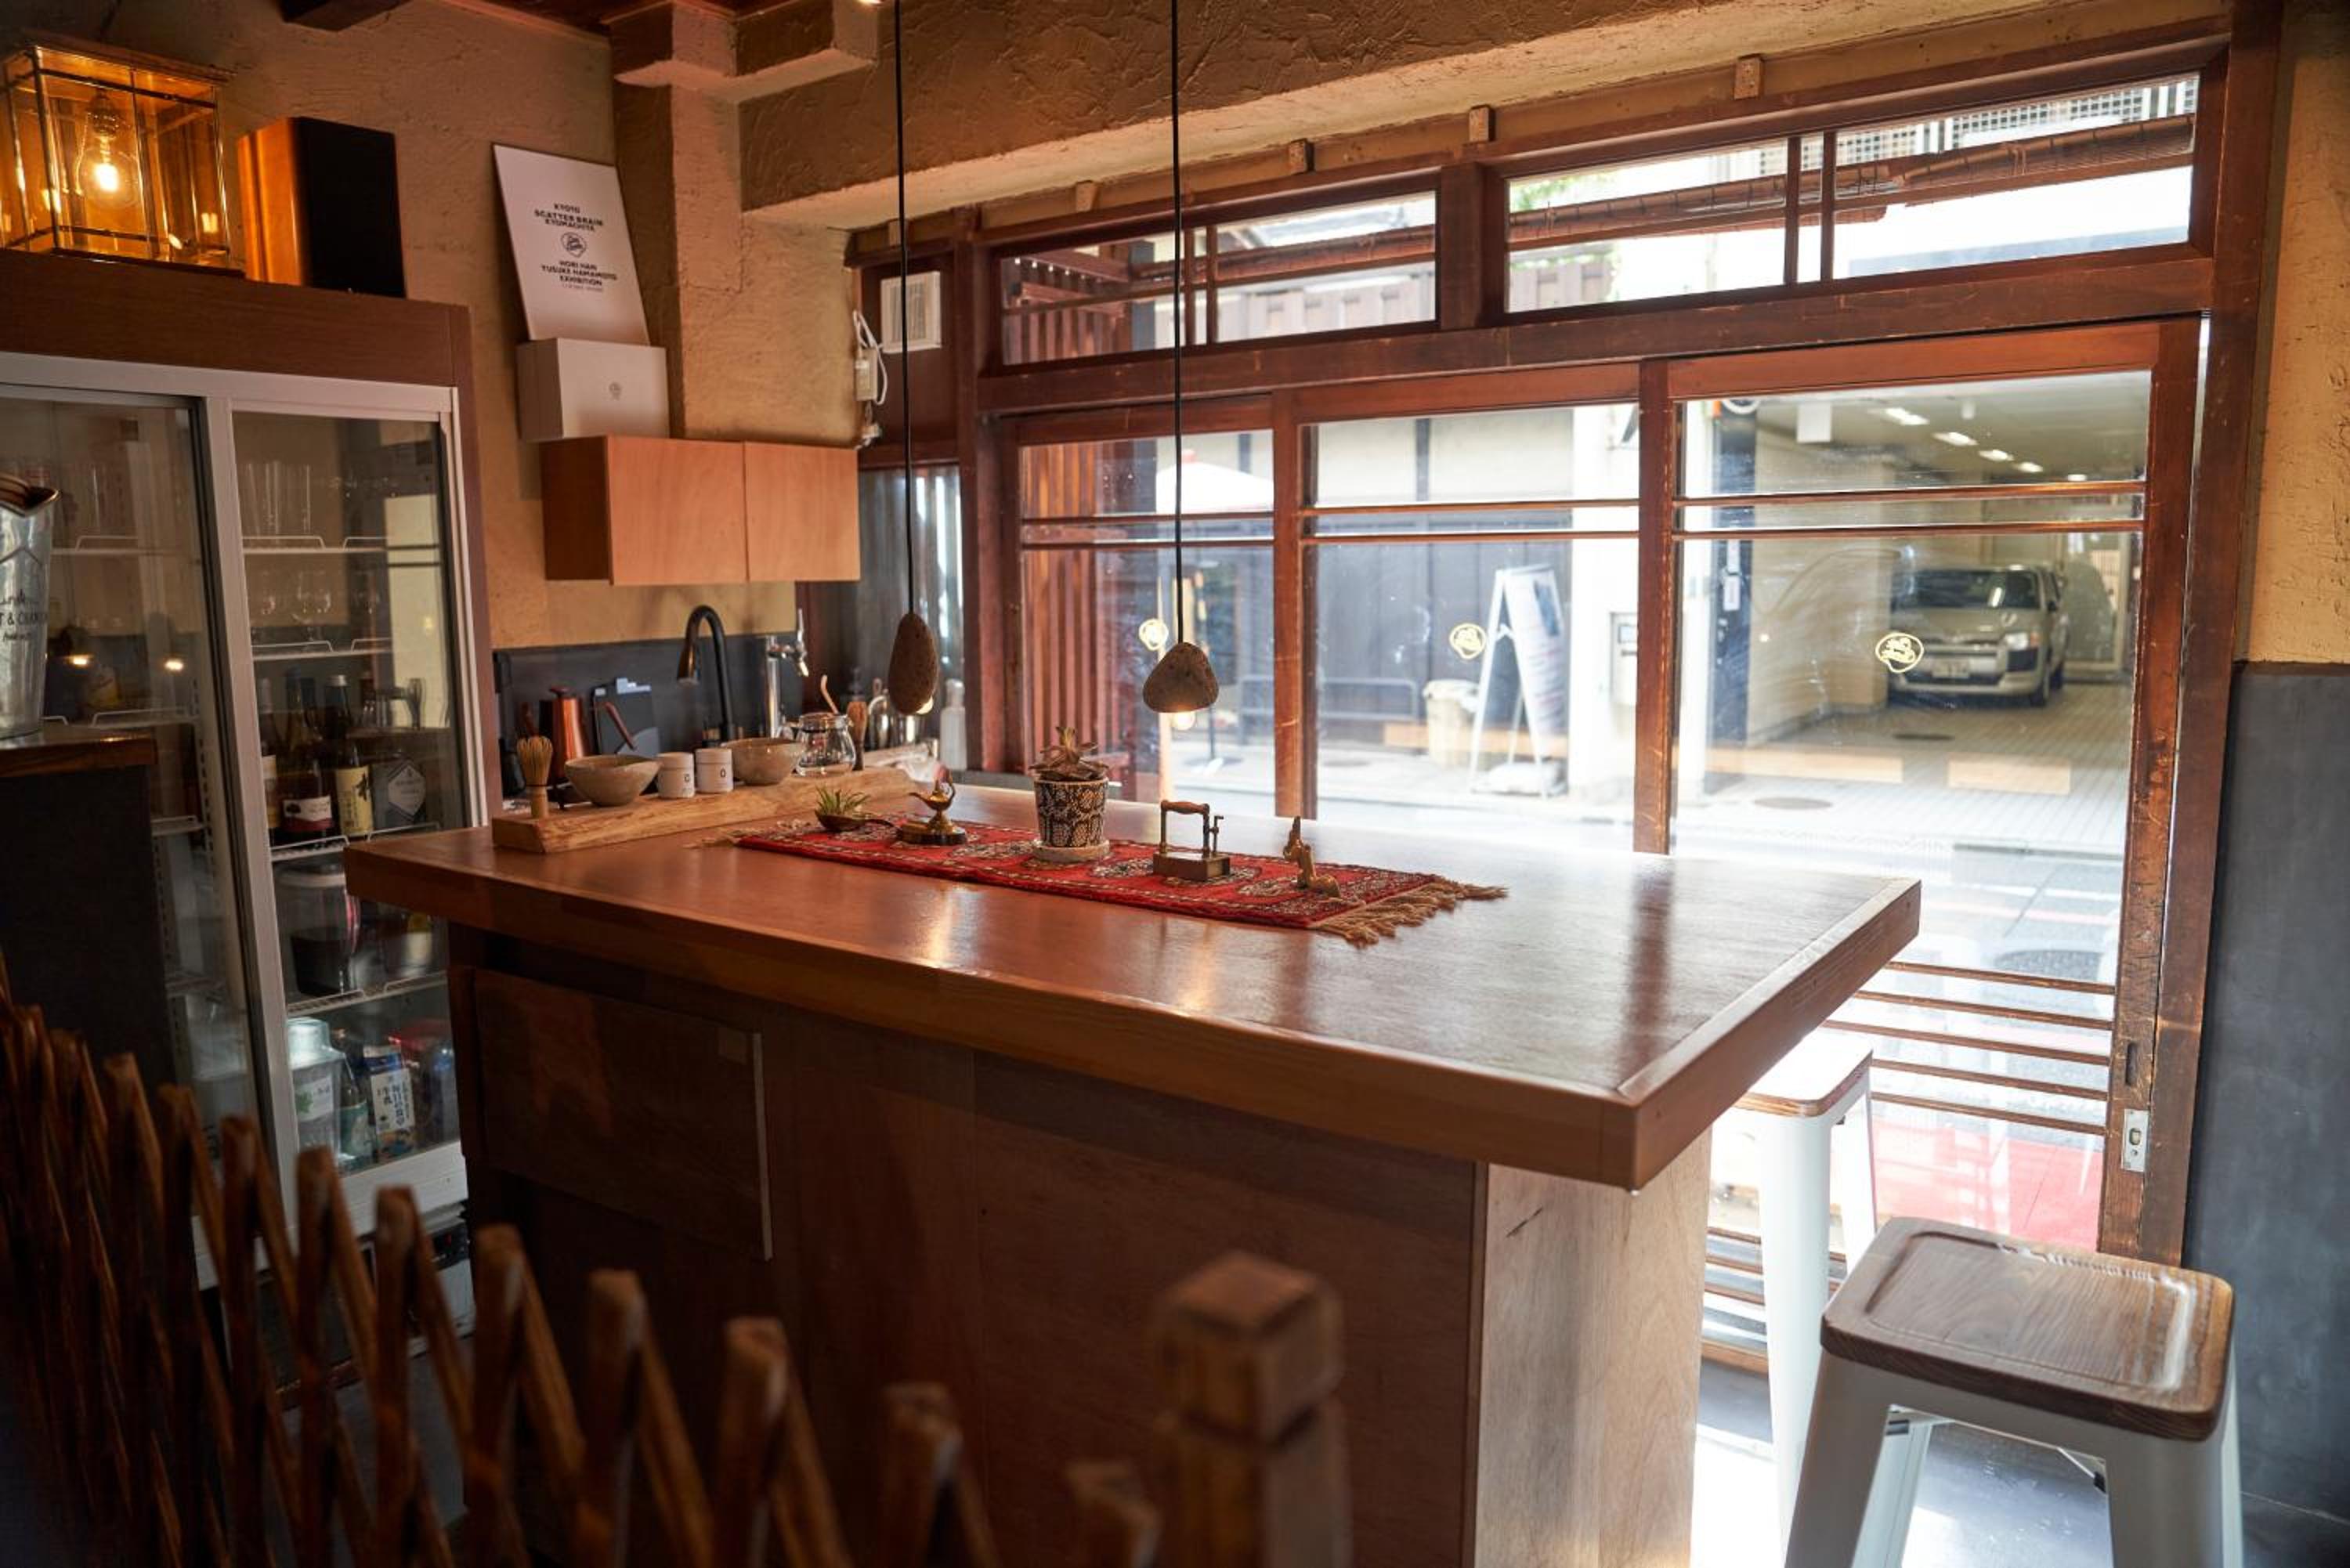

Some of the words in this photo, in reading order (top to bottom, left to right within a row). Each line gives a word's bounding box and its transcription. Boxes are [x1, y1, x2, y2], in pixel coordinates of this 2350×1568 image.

[535, 209, 575, 222] SCATTER
[576, 216, 603, 226] BRAIN
[559, 275, 602, 286] EXHIBITION
